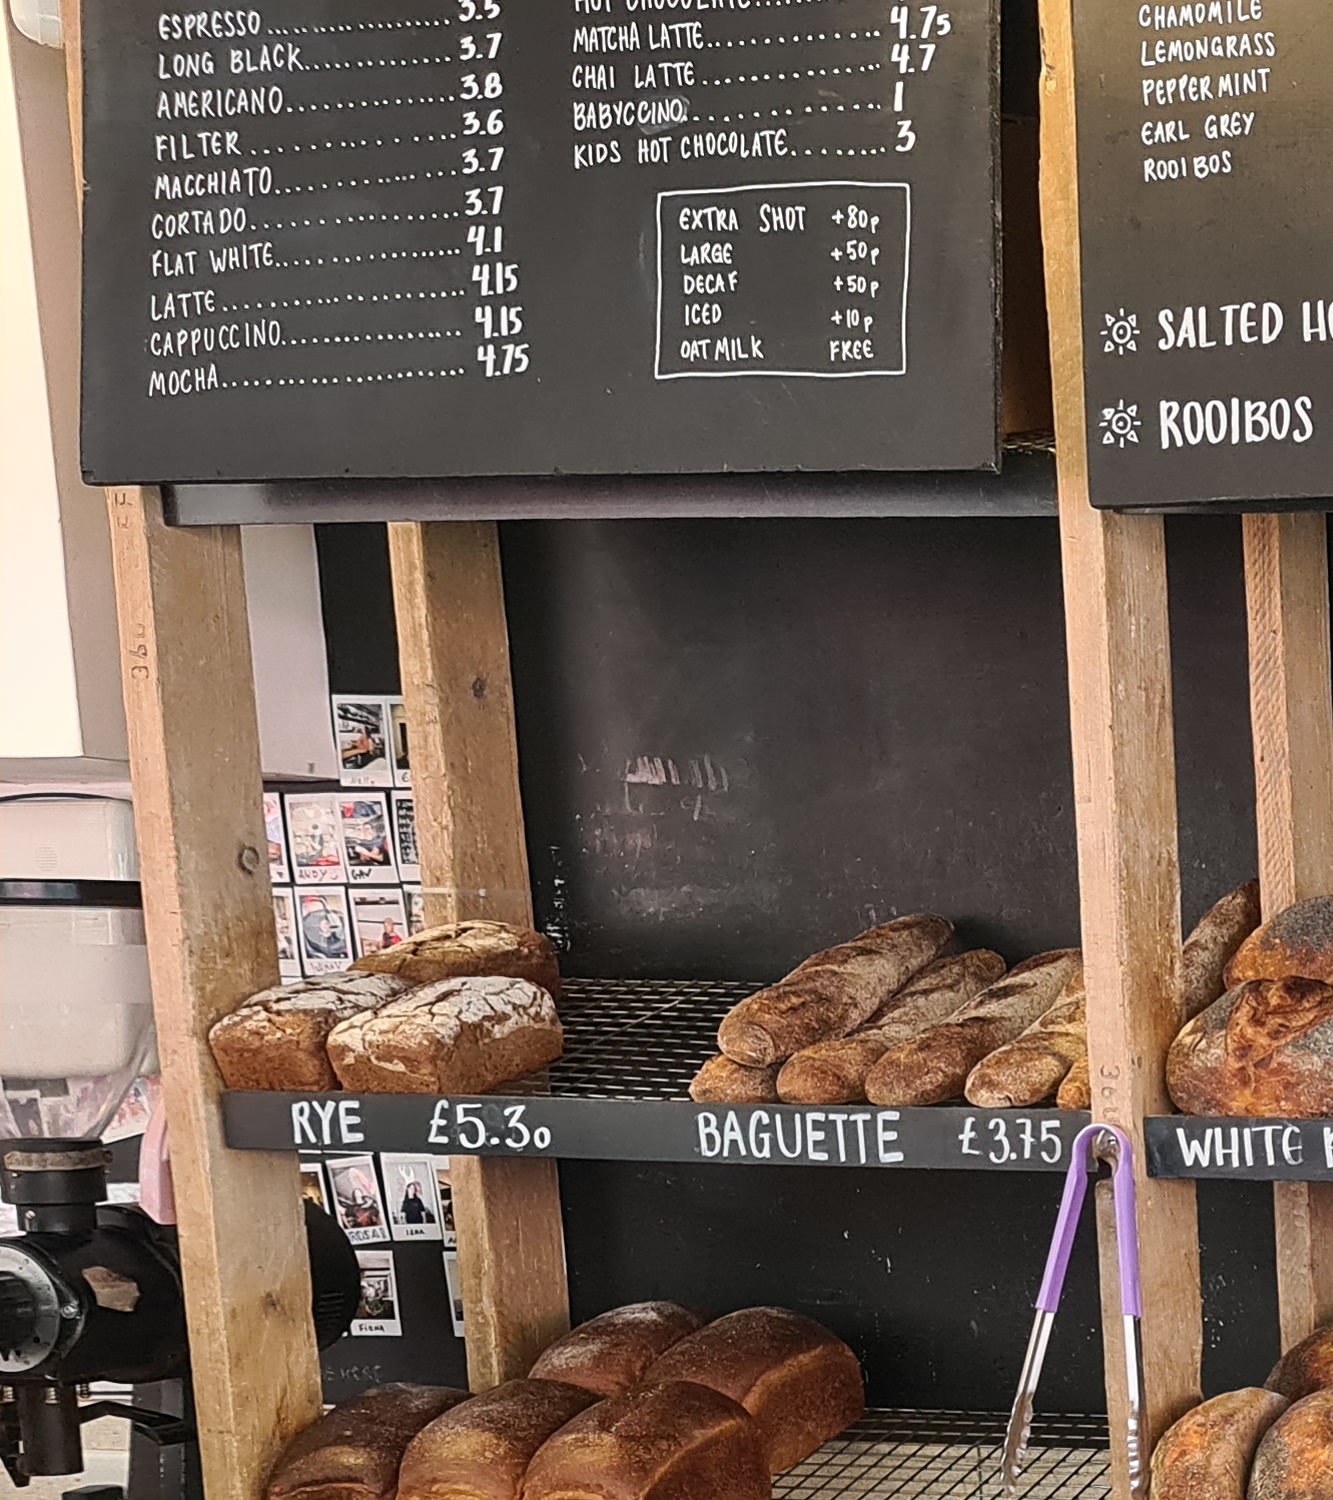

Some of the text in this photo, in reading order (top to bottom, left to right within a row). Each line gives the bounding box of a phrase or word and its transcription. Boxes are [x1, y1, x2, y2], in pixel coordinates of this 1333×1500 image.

[159, 0, 501, 41] ESPRESSO 3.5
[572, 6, 952, 54] MATCHA LATTE 4.75
[1139, 0, 1263, 28] CHAMOMILE
[158, 32, 503, 80] LONG BLACK 3.7
[572, 44, 936, 90] CHAI LATTE 4.7
[1141, 33, 1276, 67] LEMONGRASS
[157, 72, 504, 119] AMERICANO 3.8
[573, 81, 904, 131] BABYCCINO 1
[1142, 69, 1271, 106] PEPPERMINT
[155, 109, 505, 162] FILTER 3.6
[574, 120, 916, 169] KIDS HOT CHOCOLATE 3
[1141, 112, 1255, 146] EARL GREY
[155, 147, 505, 200] MACCHIATO 3.7
[1144, 150, 1233, 182] ROOIBOS
[151, 186, 505, 240] CORTADO 3.7
[679, 206, 739, 231] EXTRA
[759, 204, 806, 232] SHOT
[151, 225, 503, 278] FLAT WHITE 4.1
[680, 242, 733, 265] LARGE
[151, 263, 519, 322] LATTE 4.15
[684, 272, 738, 294] DECAF
[150, 306, 524, 357] CAPPUCCINO 4.15
[685, 304, 722, 325] ICED
[1157, 302, 1284, 350] SALTED
[149, 343, 530, 397] MOCHA 4.75
[830, 340, 874, 361] FREE
[1159, 396, 1314, 449] ROOIBOS
[292, 1099, 552, 1151] RYE £5.30
[697, 1110, 1062, 1164] BAGUETTE £3.75
[1175, 1126, 1305, 1169] WHITE
